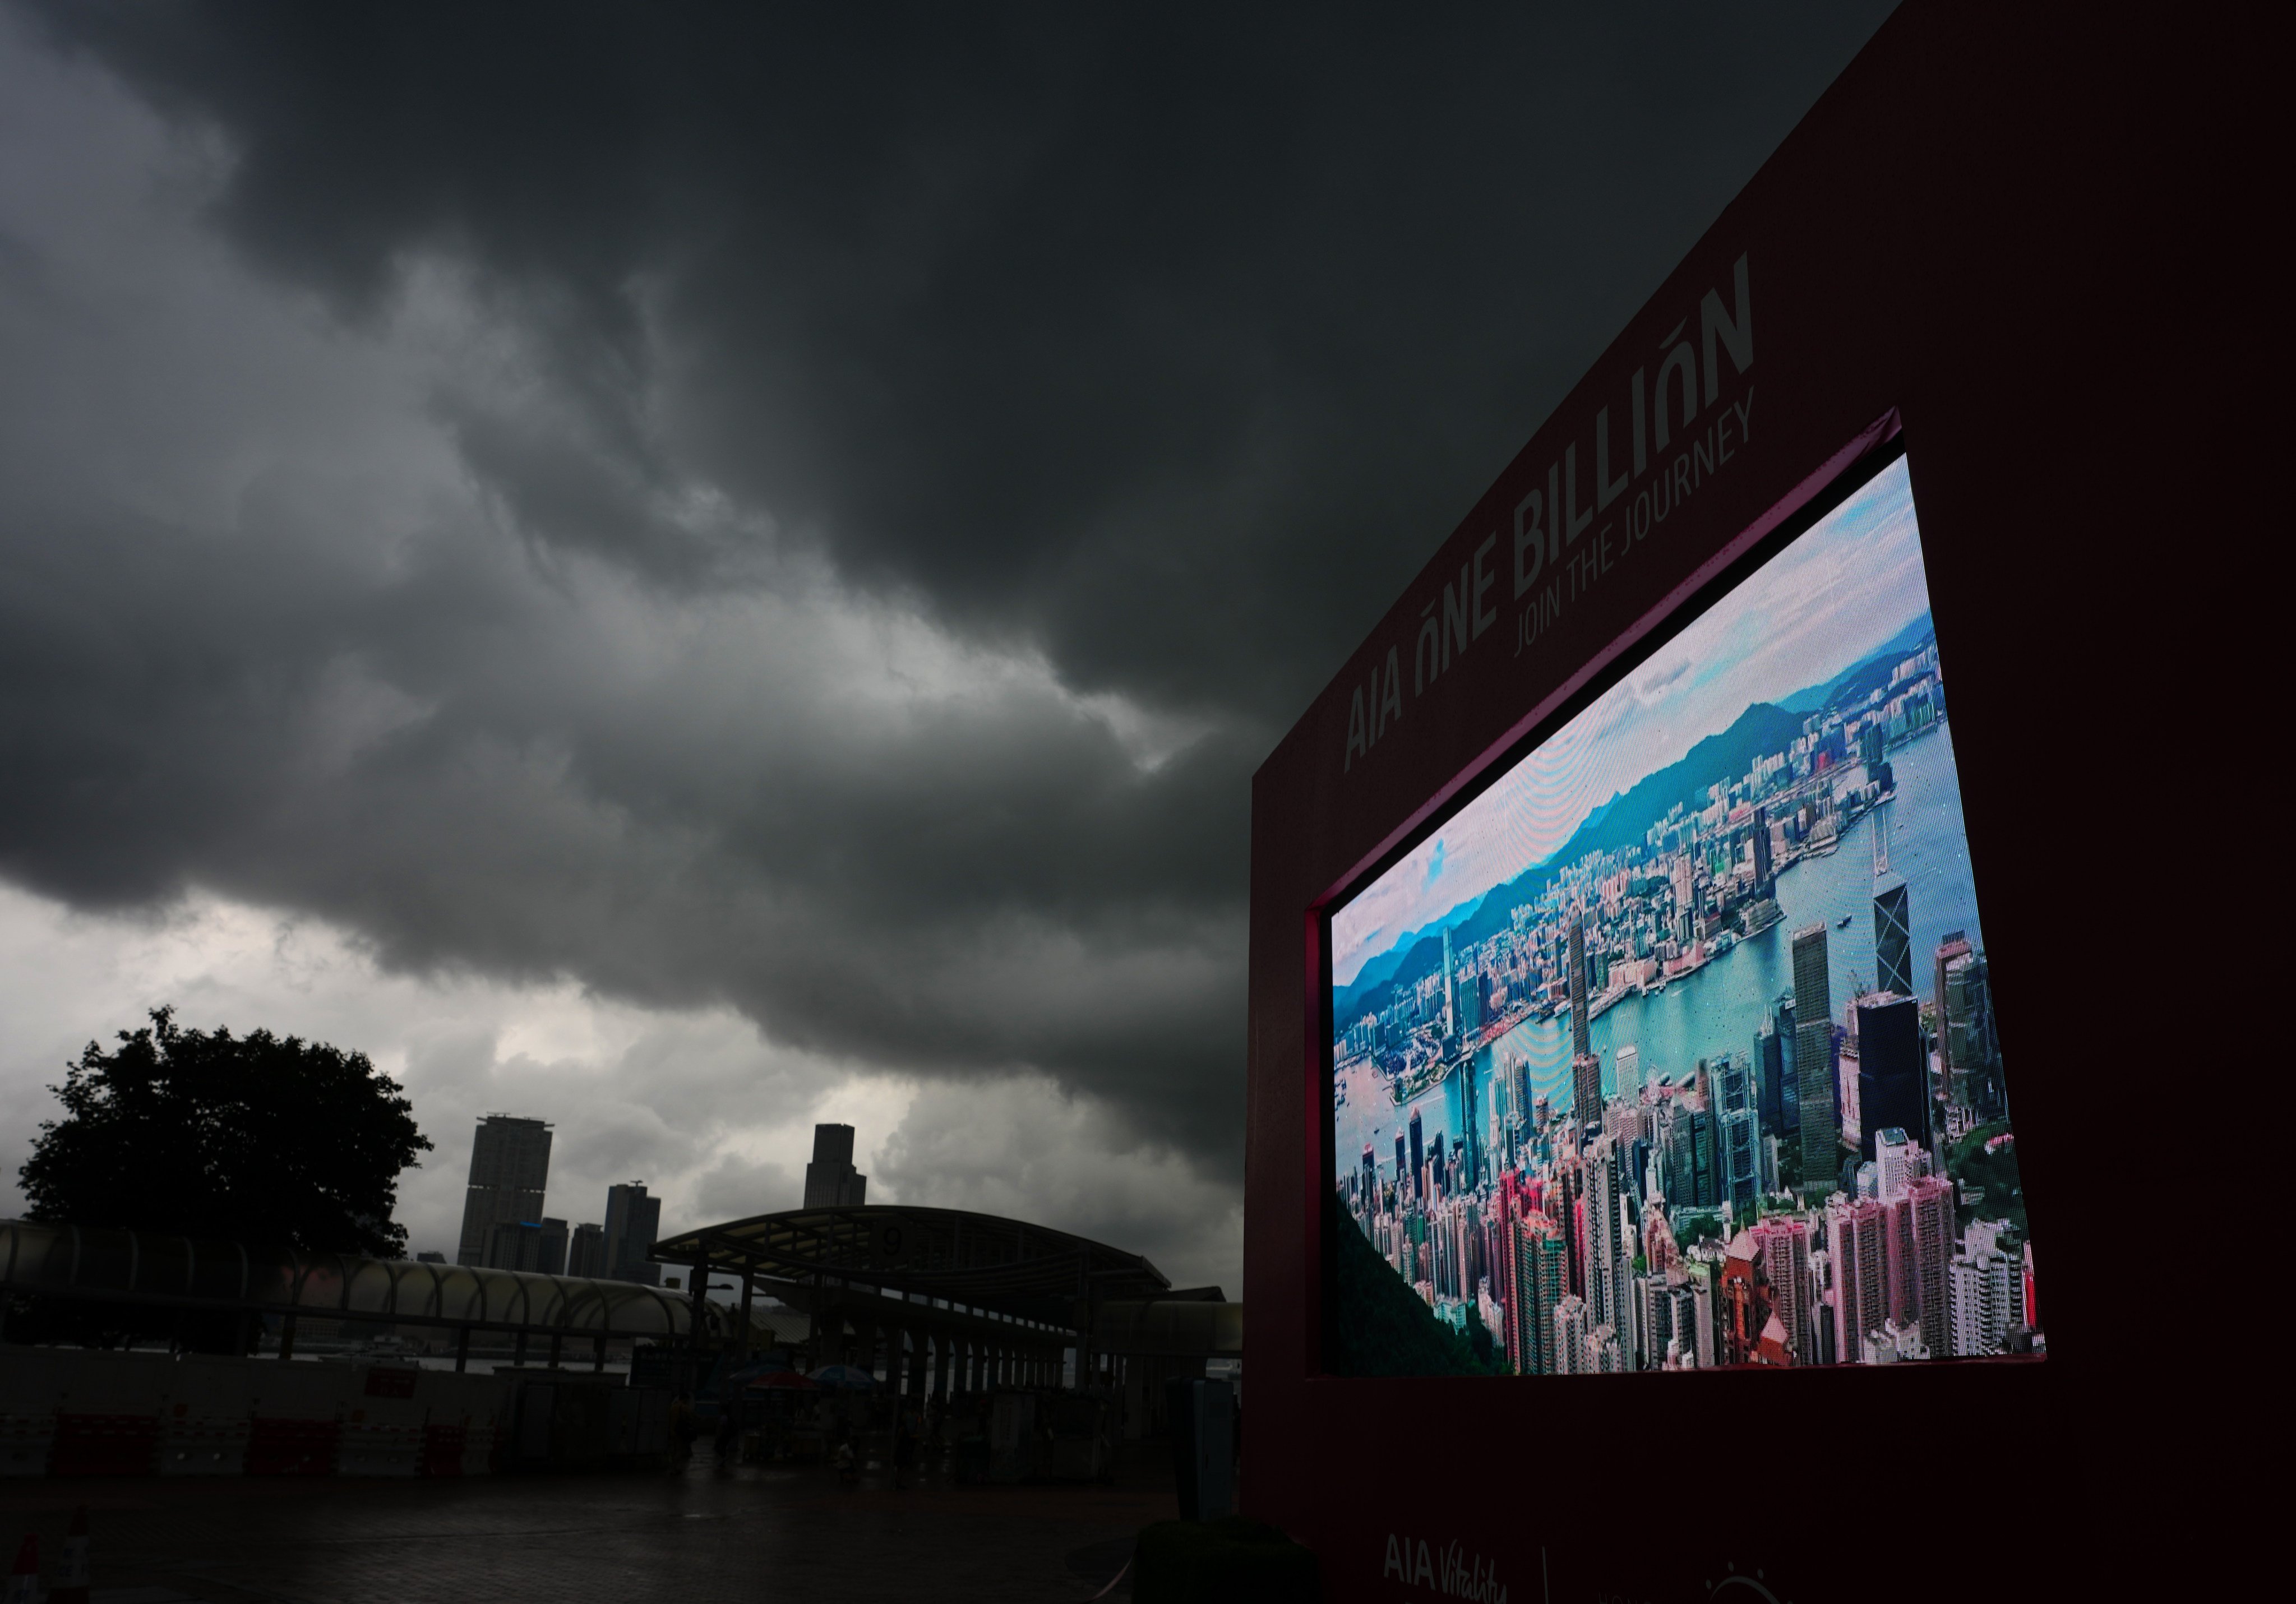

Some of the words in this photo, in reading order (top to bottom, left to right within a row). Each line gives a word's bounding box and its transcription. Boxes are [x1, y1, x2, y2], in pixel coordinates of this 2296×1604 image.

[1514, 577, 1561, 658] JOIN
[1567, 523, 1614, 603] THE
[1621, 386, 1754, 556] JOURNEY
[1344, 645, 1402, 774] AIA
[883, 1227, 902, 1256] 9
[1384, 1533, 1436, 1591] AIA
[1439, 1538, 1507, 1604] Vitality
